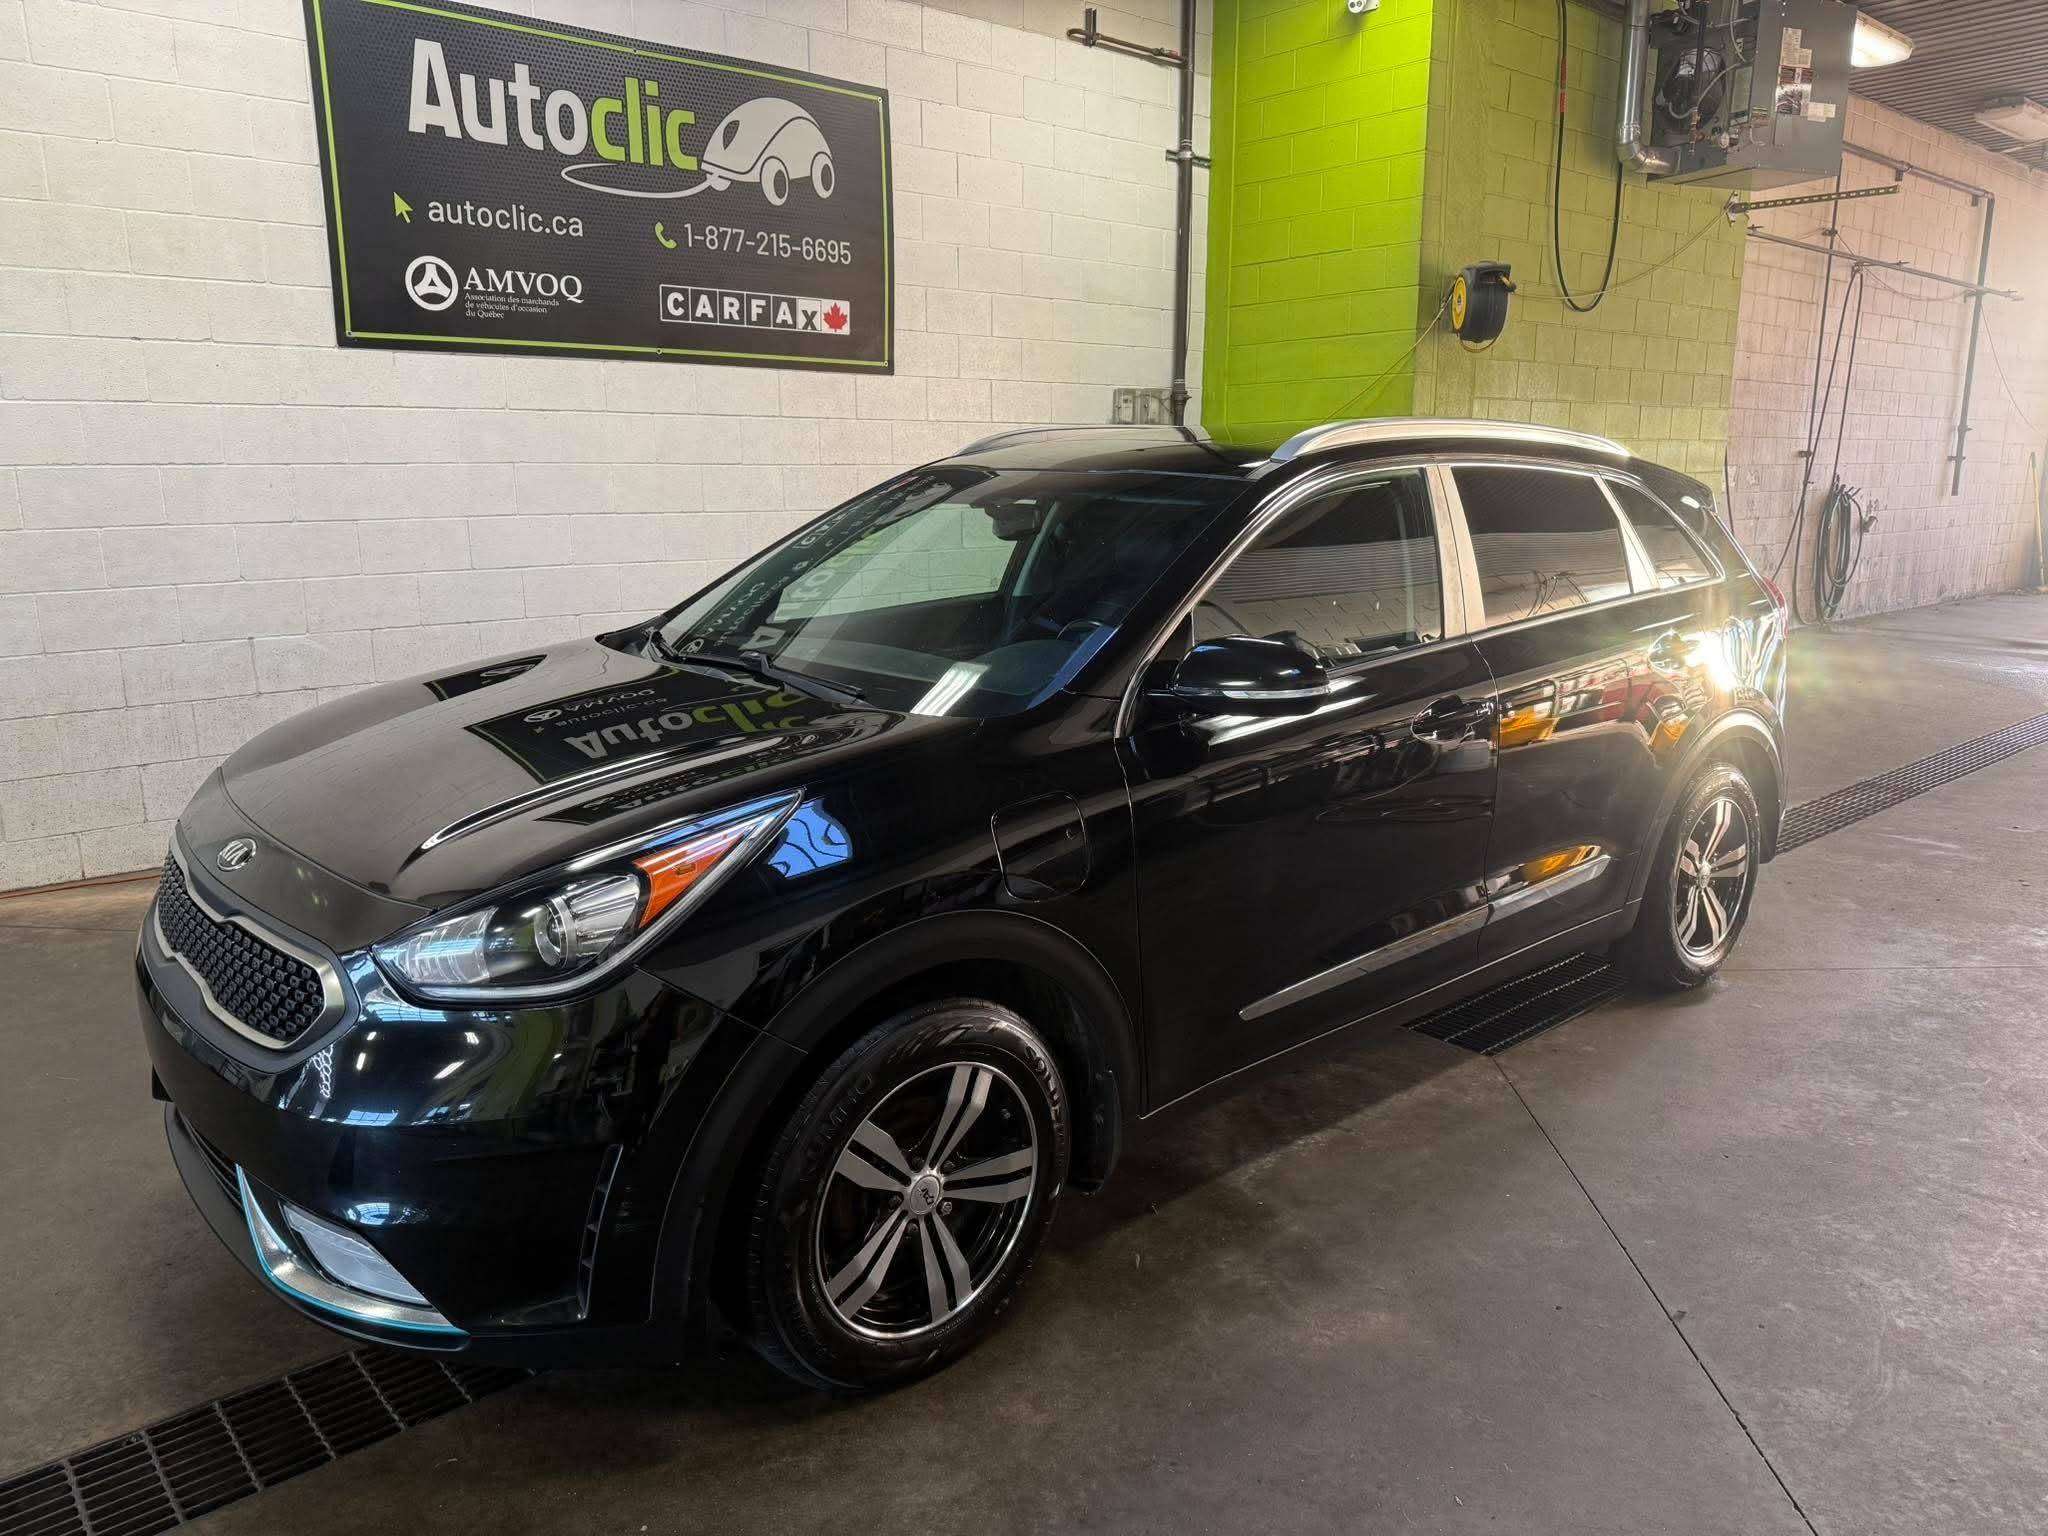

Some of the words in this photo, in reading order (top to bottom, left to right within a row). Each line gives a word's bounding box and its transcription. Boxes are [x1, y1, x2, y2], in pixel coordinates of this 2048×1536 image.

[408, 38, 698, 171] Autoclic
[428, 200, 584, 237] autoclic.ca
[684, 223, 851, 265] 1-877-215-6695
[463, 266, 584, 304] AMVOQ
[464, 292, 506, 303] Association
[521, 297, 560, 307] marchands
[464, 301, 475, 309] de
[465, 309, 476, 317] du
[666, 291, 818, 331] CARFAX
